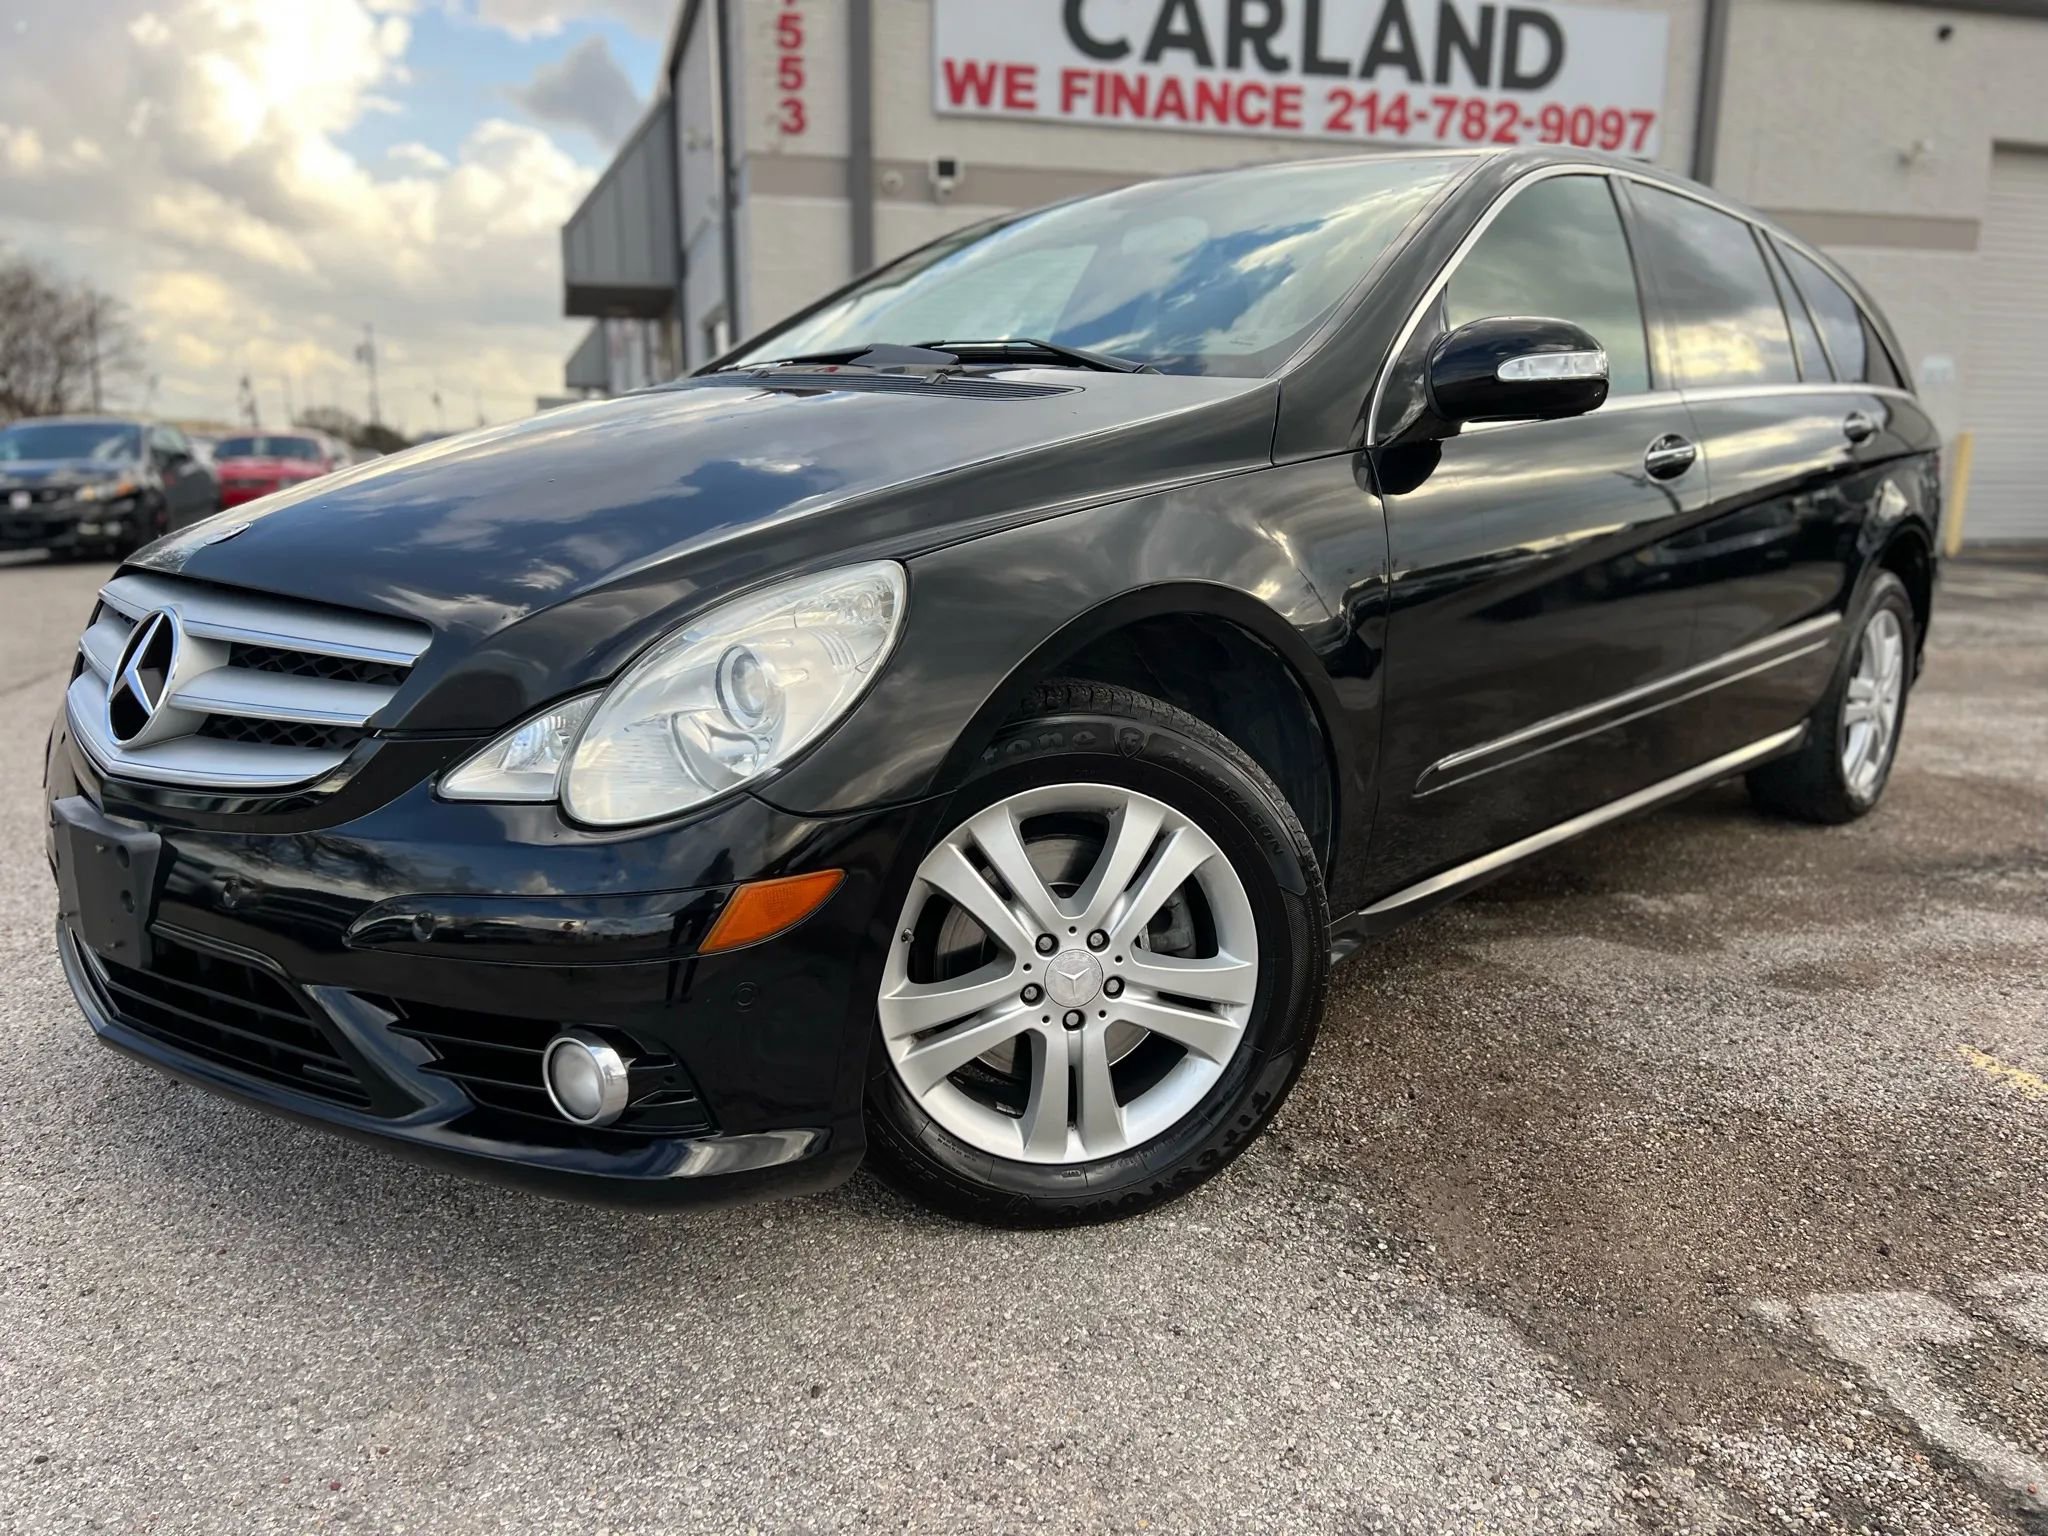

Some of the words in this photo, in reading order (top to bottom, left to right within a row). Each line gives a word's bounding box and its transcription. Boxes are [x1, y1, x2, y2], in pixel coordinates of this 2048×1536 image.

[1062, 0, 1566, 91] CARLAND
[943, 60, 1038, 110] WE
[1060, 67, 1304, 129] FINANCE
[1324, 89, 1656, 151] 214-782-9097
